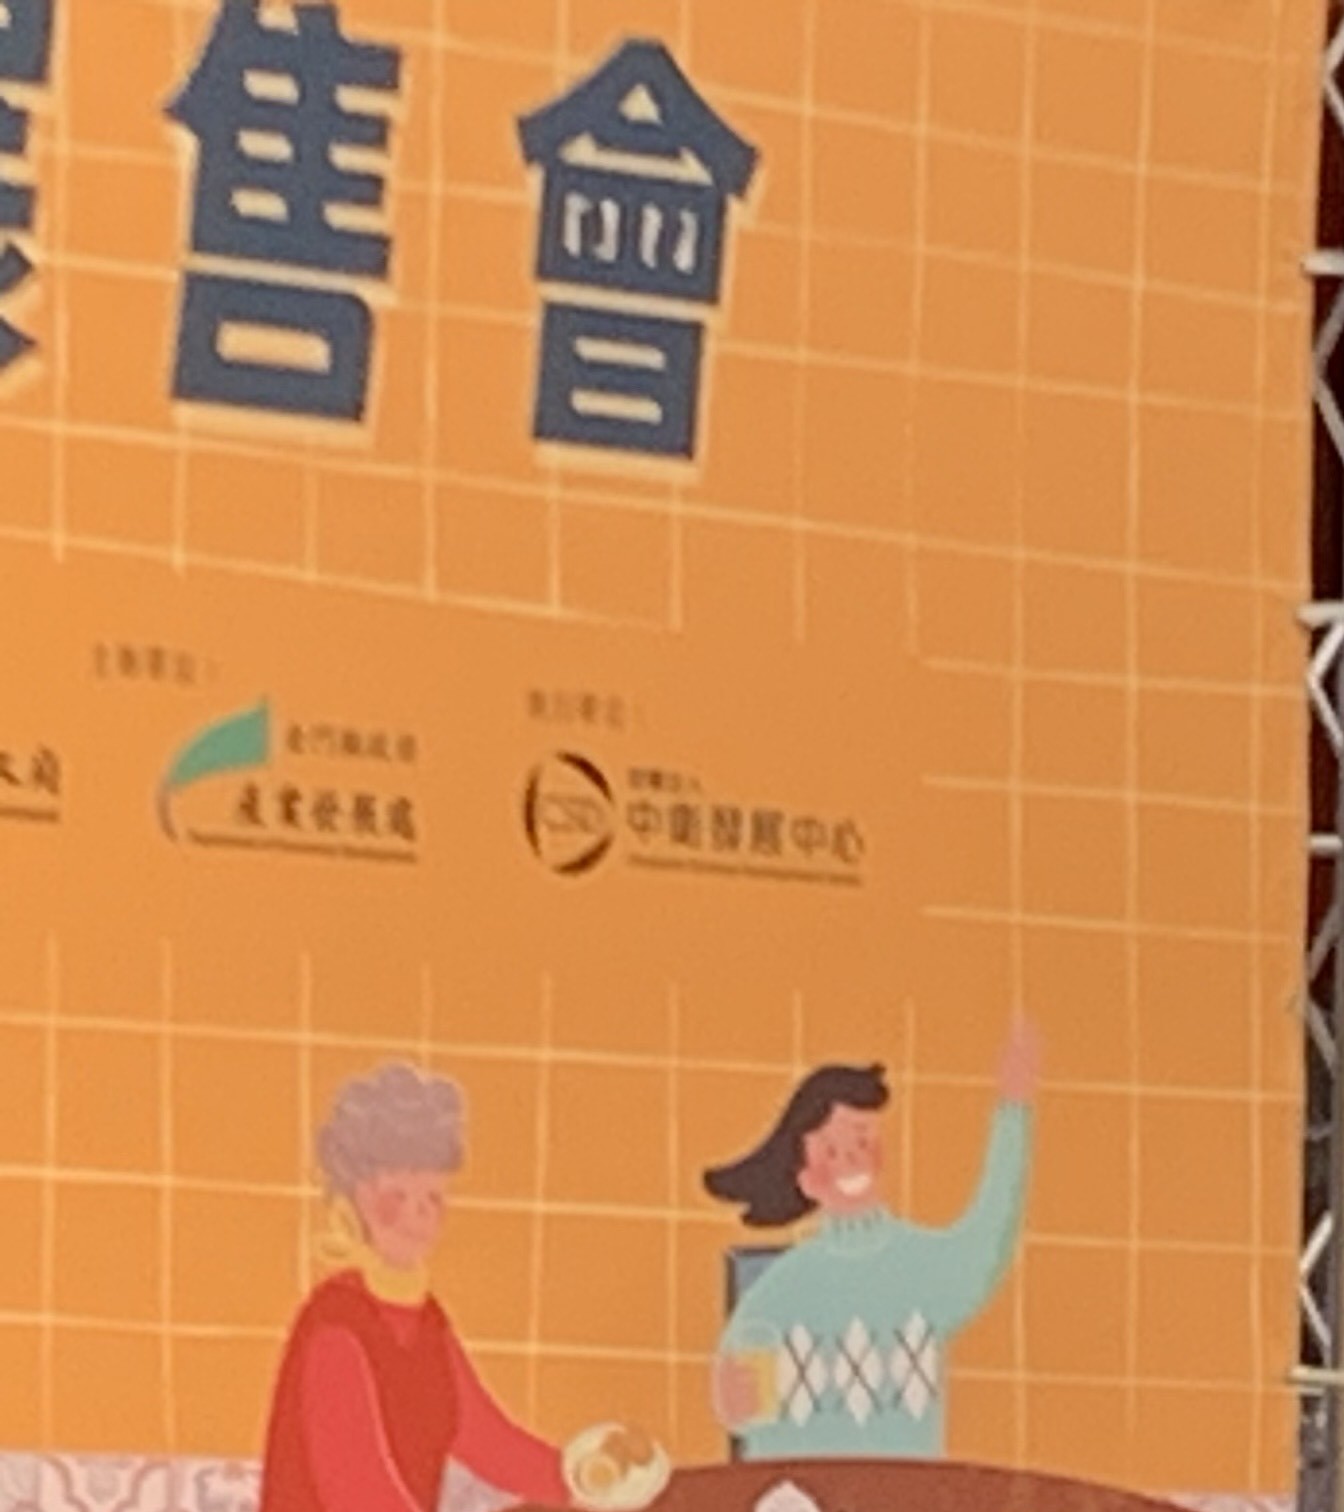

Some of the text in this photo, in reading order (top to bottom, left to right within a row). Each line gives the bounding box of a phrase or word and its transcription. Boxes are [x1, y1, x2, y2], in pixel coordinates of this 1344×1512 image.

[626, 798, 866, 865] 中衛發展中心
